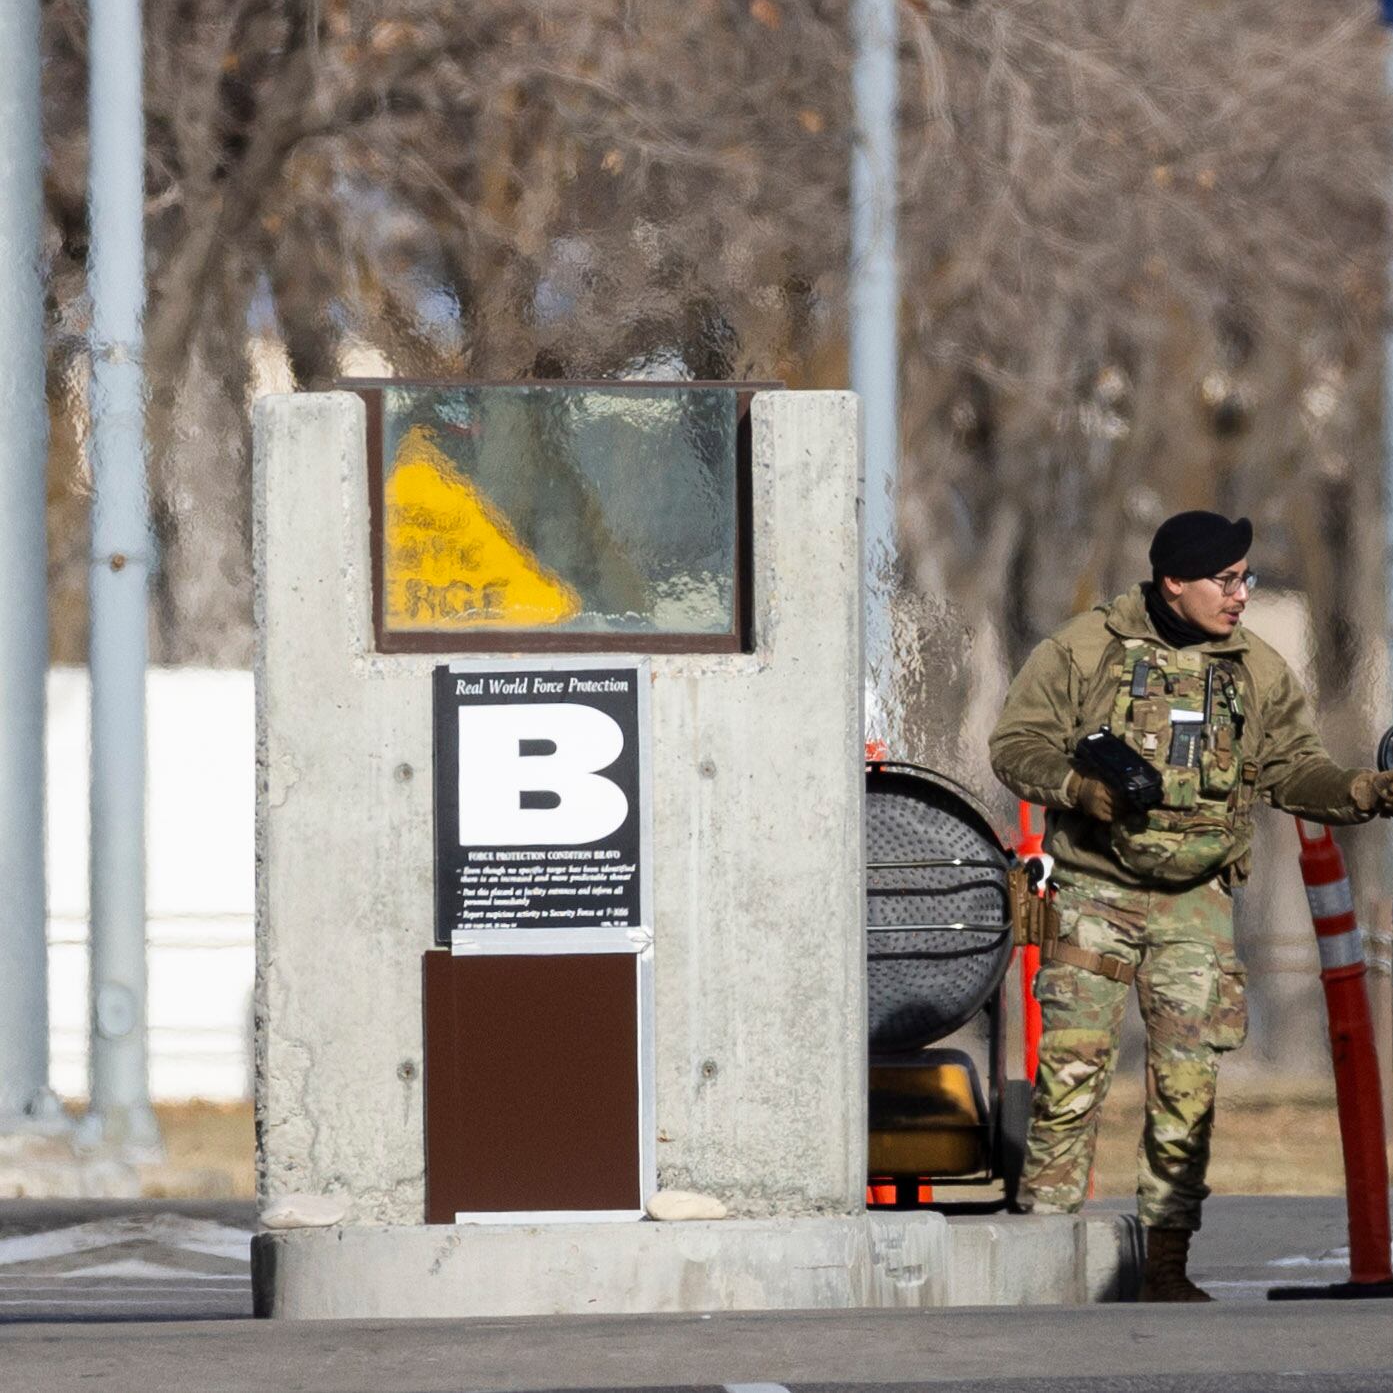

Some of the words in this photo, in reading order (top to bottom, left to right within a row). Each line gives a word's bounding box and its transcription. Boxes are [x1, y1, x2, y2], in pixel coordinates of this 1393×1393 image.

[455, 678, 484, 695] Real
[488, 677, 528, 695] World
[532, 677, 563, 694] Force
[568, 676, 629, 693] Protection
[458, 703, 629, 847] B
[496, 851, 546, 861] PROTECTION
[547, 851, 592, 860] CONDITION
[593, 850, 621, 859] BRAVO
